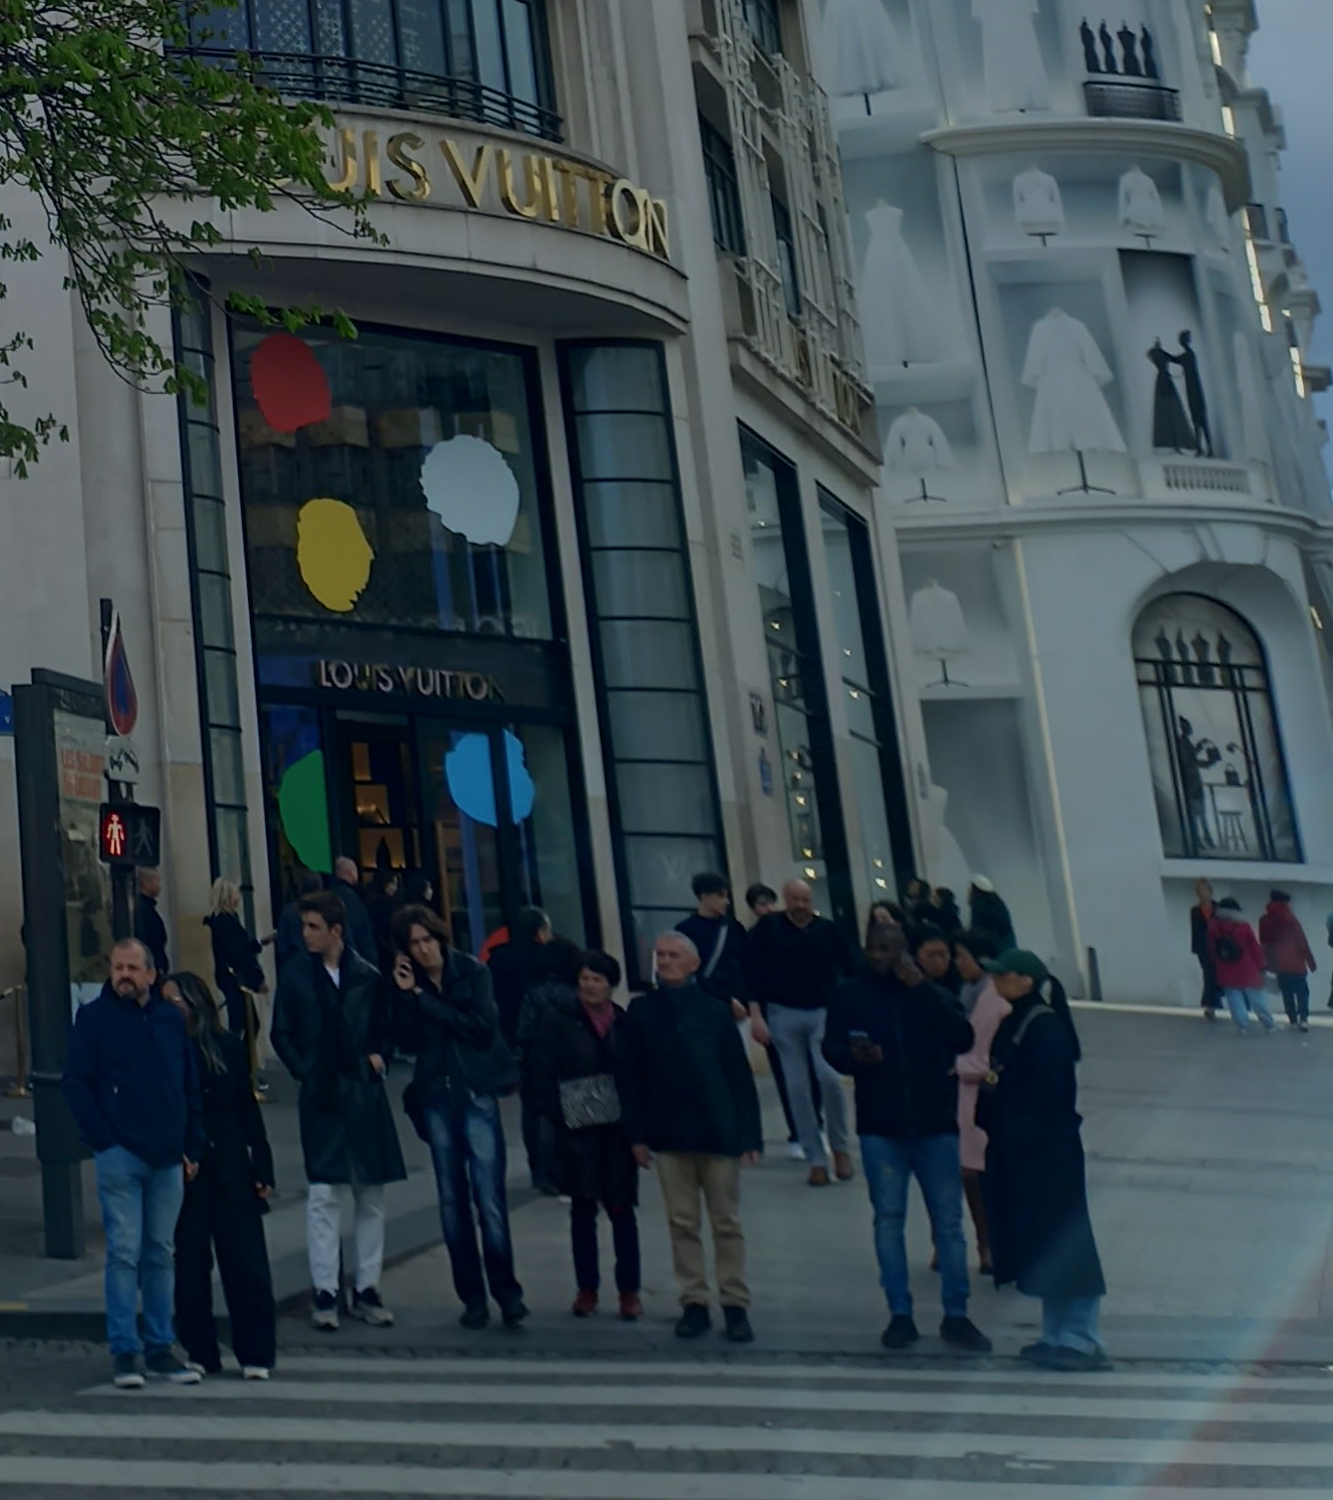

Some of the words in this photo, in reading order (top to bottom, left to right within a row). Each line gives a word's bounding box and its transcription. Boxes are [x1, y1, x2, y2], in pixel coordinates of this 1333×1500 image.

[439, 139, 670, 261] VUITTON
[318, 659, 394, 693] LOUIS
[398, 664, 505, 701] VUITTON
